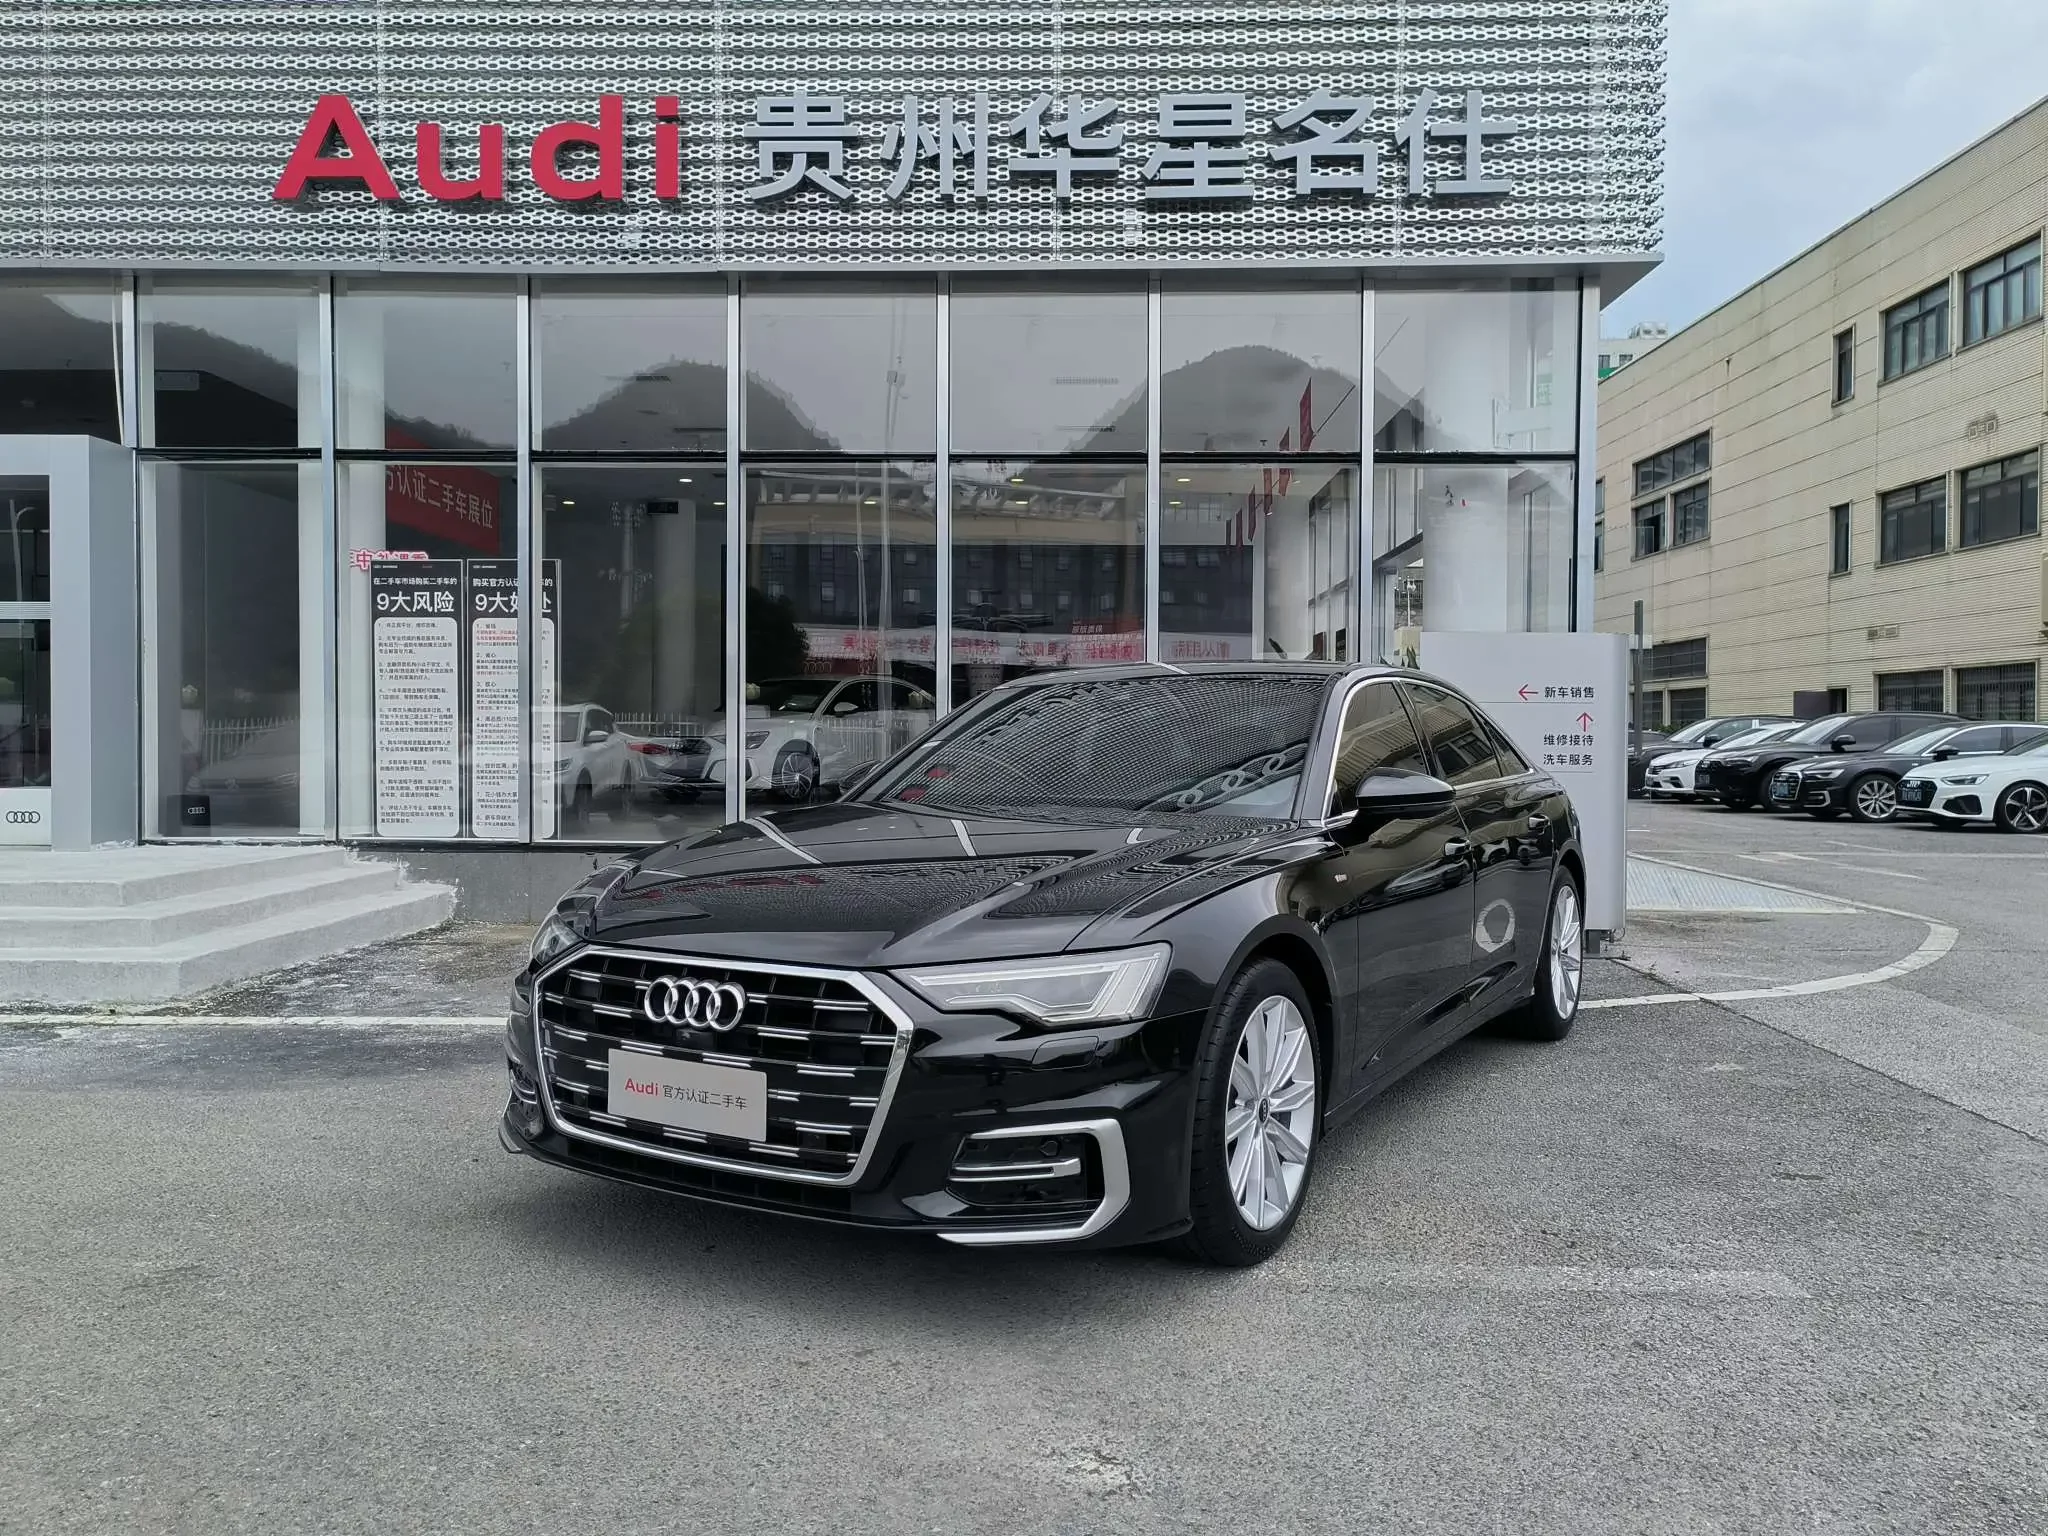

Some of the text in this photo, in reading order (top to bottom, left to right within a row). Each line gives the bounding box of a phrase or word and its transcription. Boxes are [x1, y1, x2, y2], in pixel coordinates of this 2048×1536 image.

[272, 89, 1518, 200] Audi 贵州华星名仕
[373, 577, 458, 586] 在二手车市场购买二手车的
[376, 590, 455, 613] 9大风险
[1543, 686, 1595, 699] 新车销售
[1543, 734, 1594, 747] 维修接待
[1543, 753, 1594, 766] 洗车服务
[624, 1077, 748, 1110] Audi 官方认证二手车
